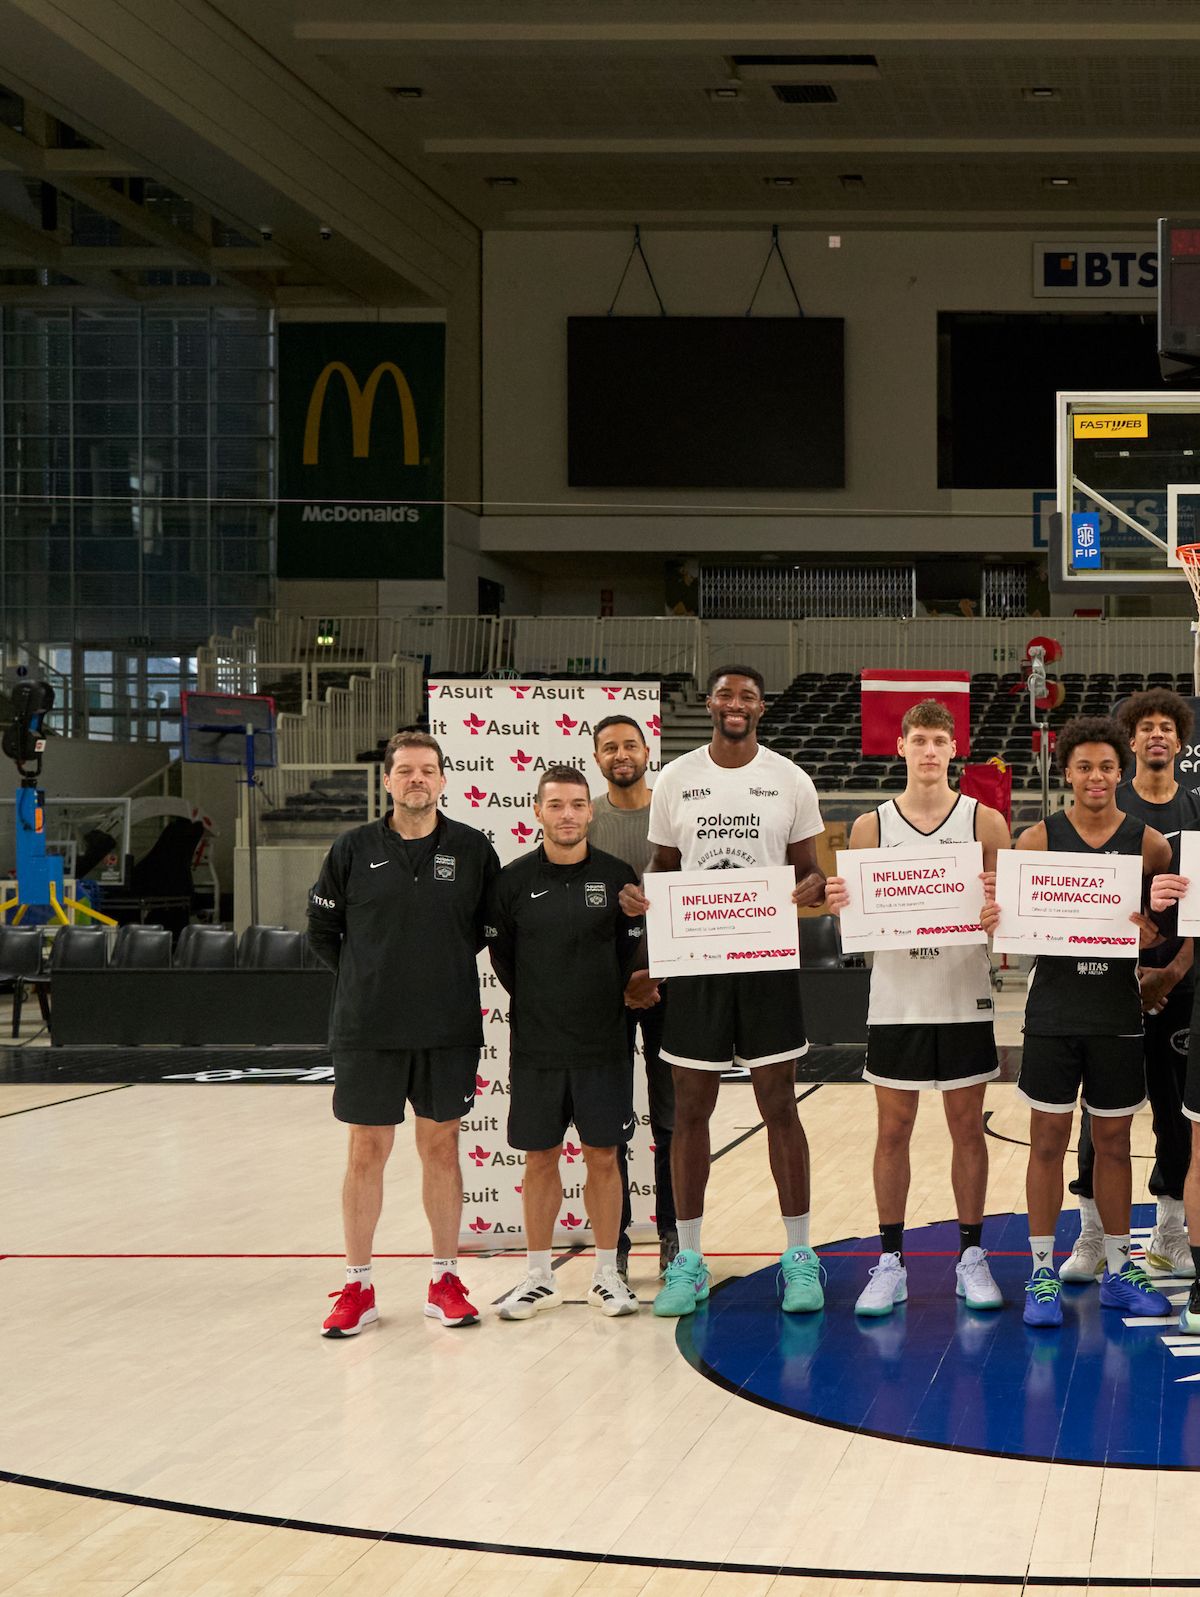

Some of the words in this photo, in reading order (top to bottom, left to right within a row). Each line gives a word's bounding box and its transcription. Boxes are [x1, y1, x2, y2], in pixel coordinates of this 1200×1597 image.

[1085, 252, 1158, 288] BTS
[1080, 420, 1142, 430] FASTWEB
[301, 505, 420, 523] McDonald's
[1075, 549, 1098, 558] FIP
[486, 720, 540, 735] Asuit
[692, 788, 711, 797] ITAS
[698, 848, 724, 867] AQUILA
[725, 847, 757, 865] BASKET
[873, 868, 946, 882] INFLUENZA?
[1031, 875, 1105, 888] INFLUENZA?
[874, 882, 965, 898] #IOMIVACCINO
[682, 892, 758, 906] INFLUENZA?
[1031, 891, 1121, 905] #IOMIVACCINO
[684, 906, 777, 922] #IOMIVACCINO
[920, 948, 939, 956] ITAS
[1088, 962, 1108, 971] ITAS
[460, 1116, 498, 1131] suit
[462, 1188, 499, 1203] suit
